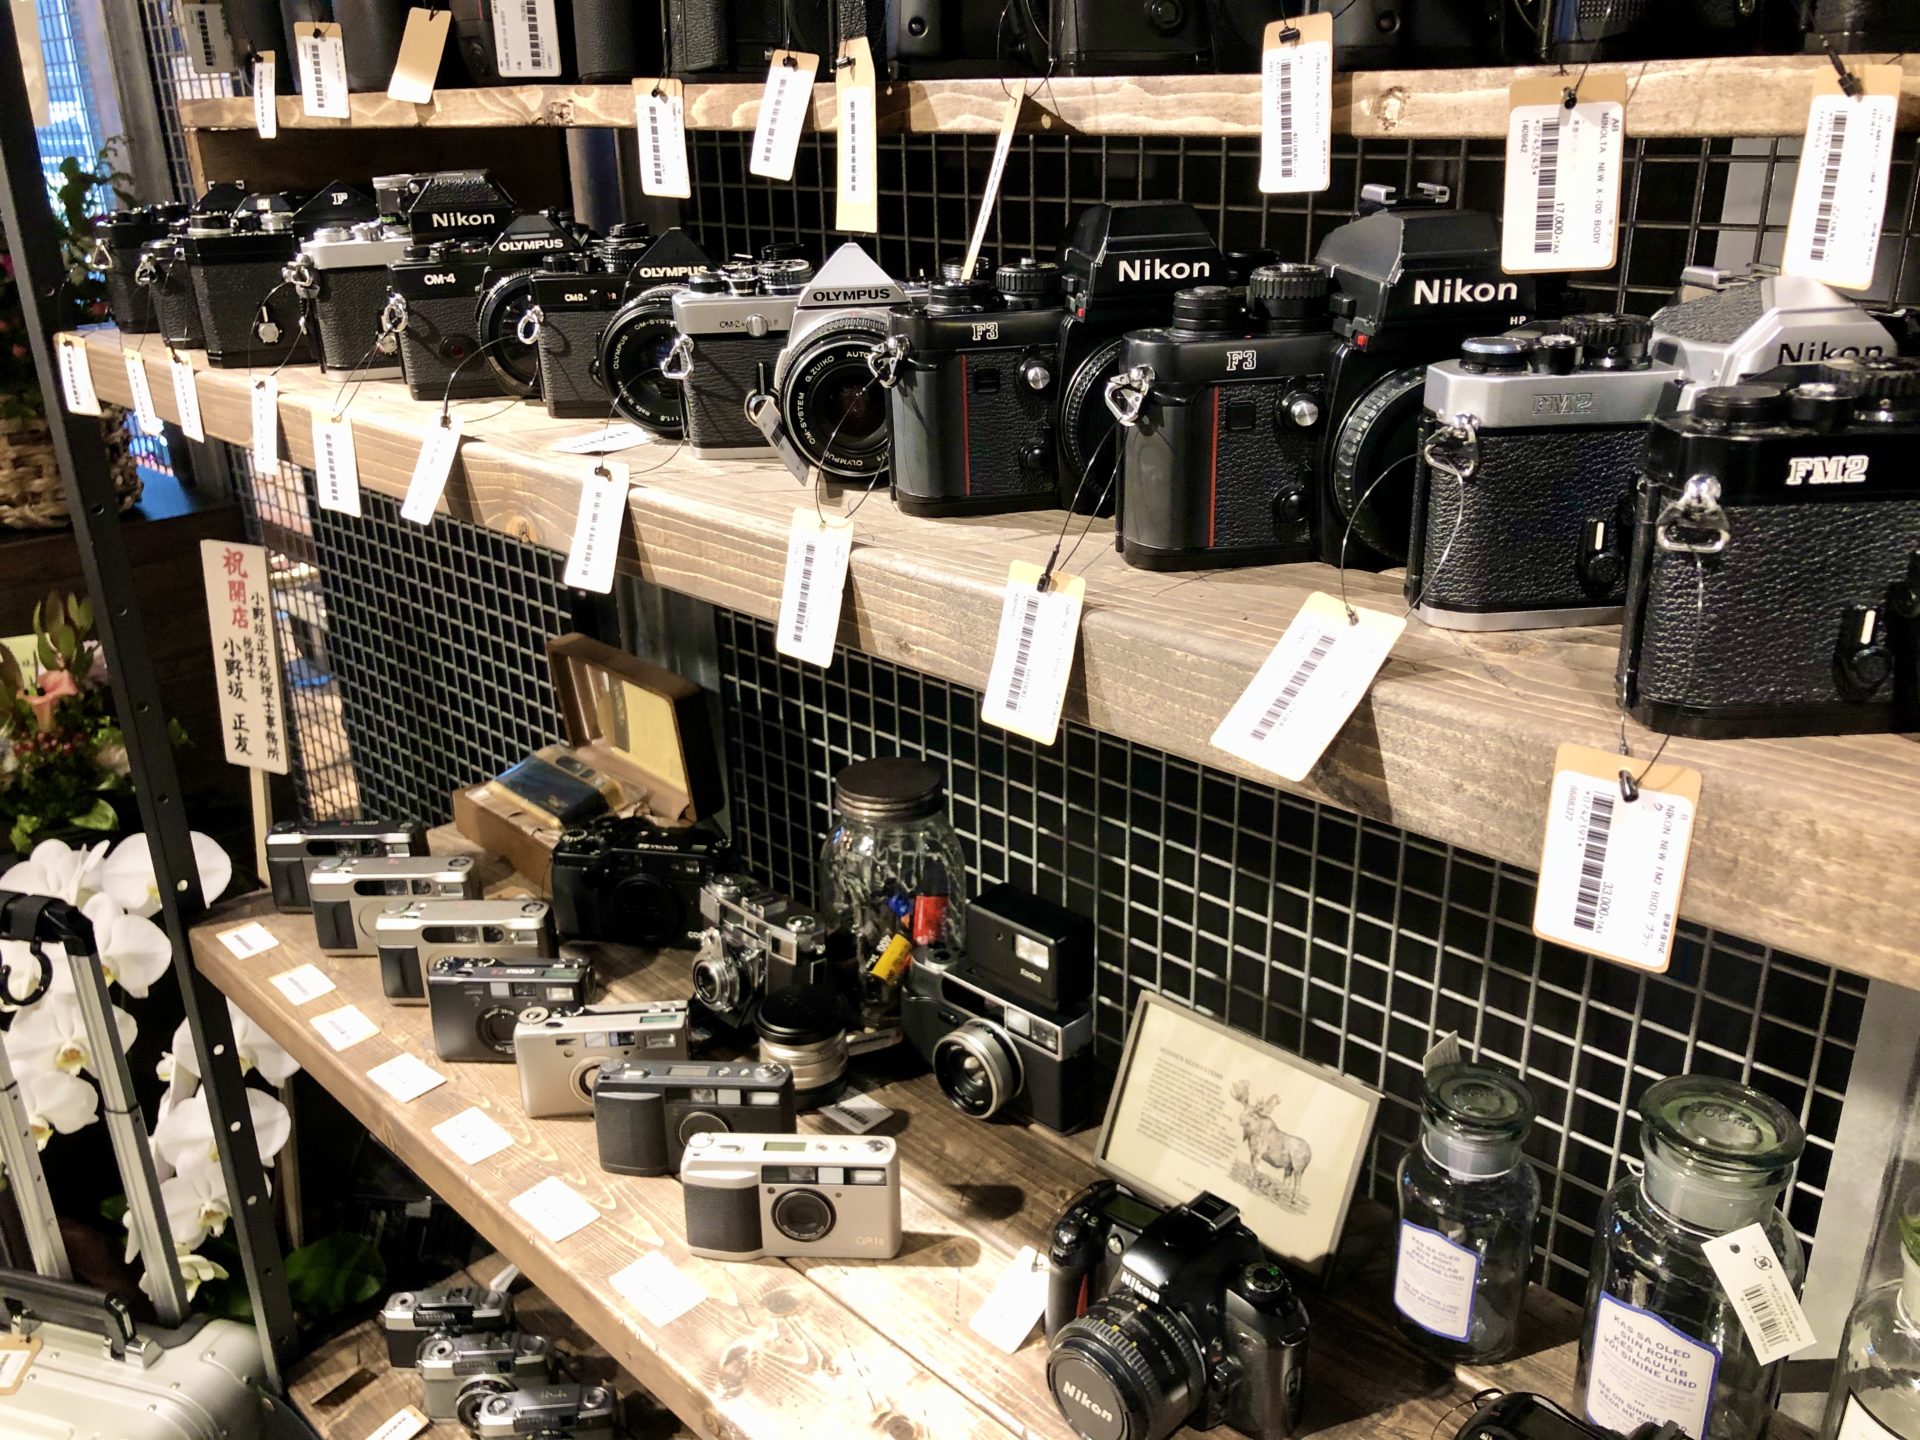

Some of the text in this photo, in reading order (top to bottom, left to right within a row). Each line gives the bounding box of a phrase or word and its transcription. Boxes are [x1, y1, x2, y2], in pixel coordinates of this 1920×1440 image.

[1593, 112, 1610, 244] MINOLTA NEW X-700 BODY
[432, 212, 495, 228] Nikon
[499, 239, 564, 252] OLYMPUS
[424, 273, 456, 286] OM-4
[639, 265, 710, 279] OLYMPUS
[1118, 258, 1210, 283] Nikon
[813, 288, 890, 303] OLYMPUS
[1413, 278, 1518, 305] Nikon
[972, 322, 999, 341] F3
[1509, 316, 1527, 325] HP
[613, 334, 629, 370] OLYMPUS
[1227, 350, 1257, 371] F3
[1778, 342, 1884, 364] Nikon
[804, 355, 835, 383] G.ZUIKO
[1531, 392, 1593, 415] FM2
[797, 392, 816, 446] OM-SYSTEM
[825, 451, 863, 467] OLYMPUS
[1785, 455, 1869, 486] FM2
[222, 548, 249, 629] 祝開店
[1662, 804, 1675, 835] NIKON
[1658, 839, 1669, 862] NEW
[1647, 891, 1660, 917] BODY
[1120, 1271, 1161, 1305] Nikon
[1613, 1315, 1691, 1360] KAS SA OLED
[1620, 1331, 1643, 1350] SIIN
[1613, 1335, 1688, 1377] KES LAULAB
[1621, 1351, 1662, 1378] SININE
[1665, 1375, 1697, 1389] LIND
[1062, 1380, 1114, 1423] Nikon
